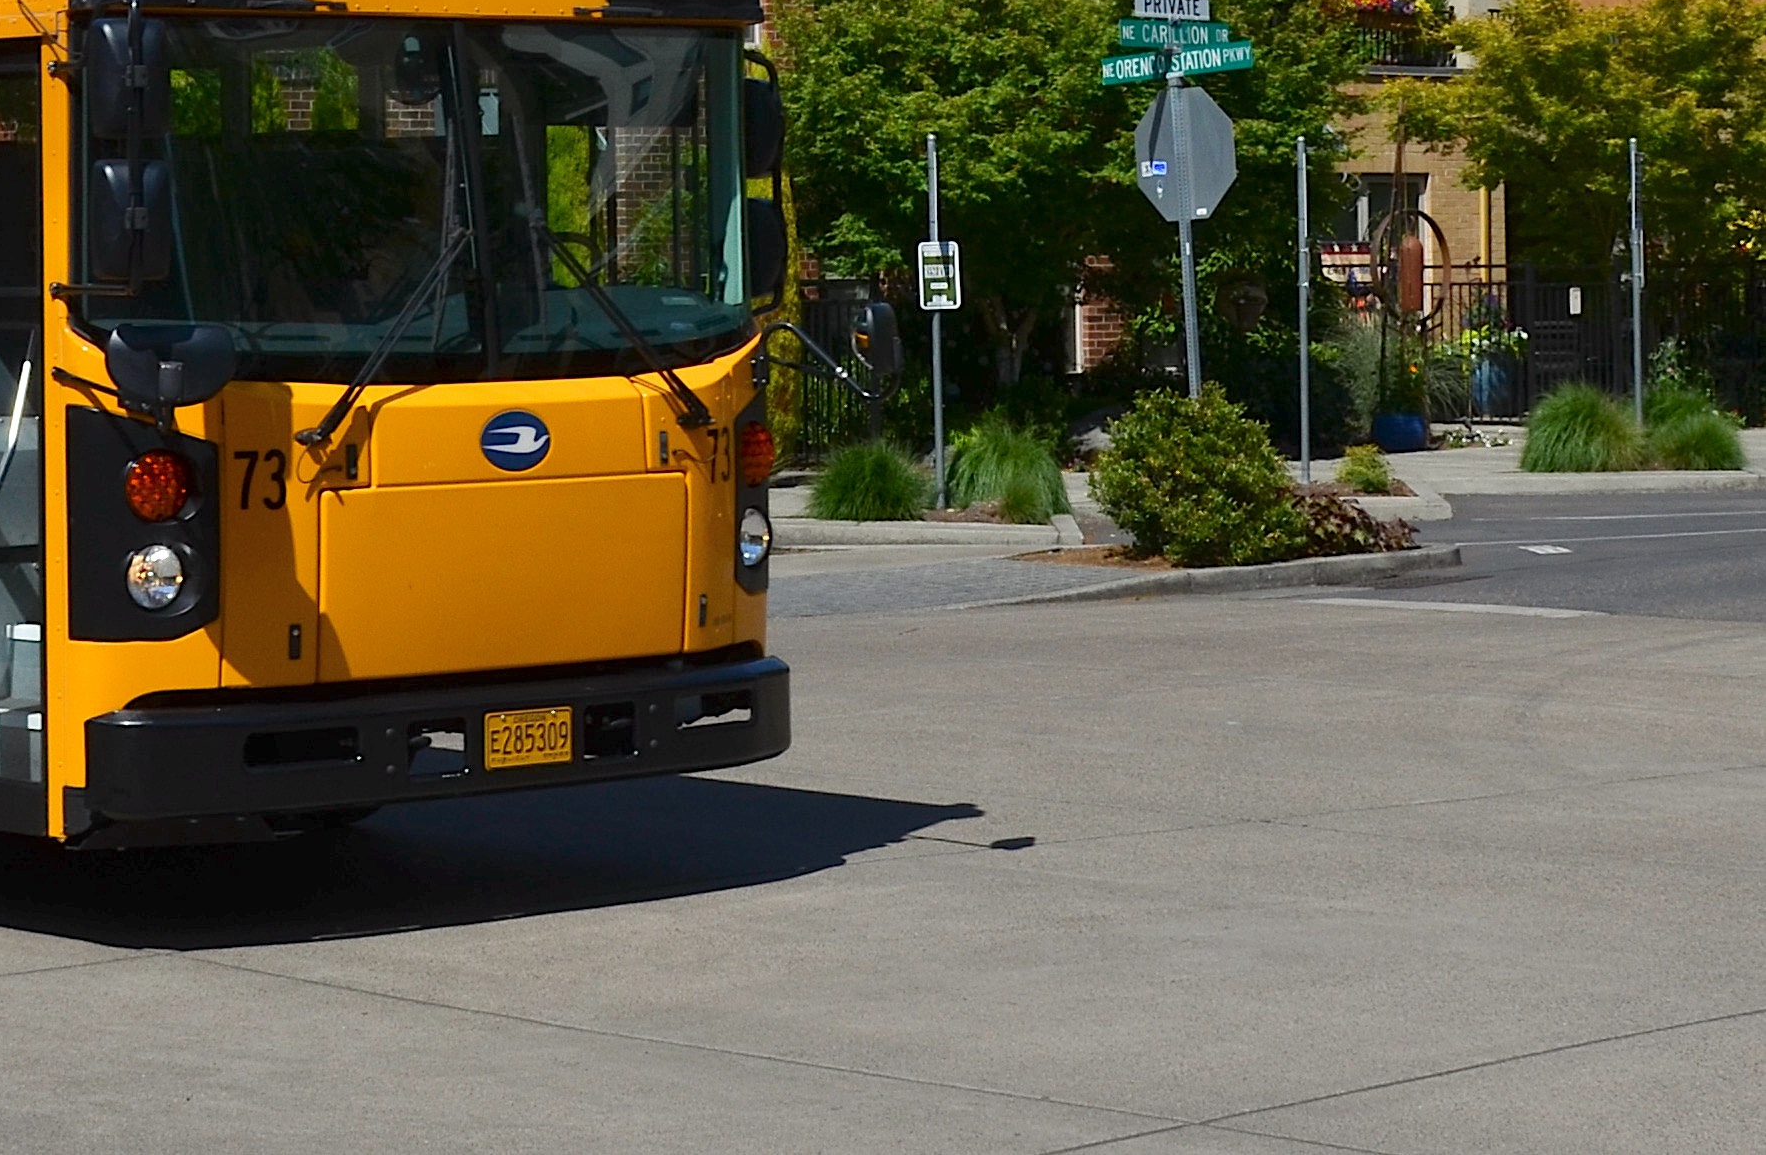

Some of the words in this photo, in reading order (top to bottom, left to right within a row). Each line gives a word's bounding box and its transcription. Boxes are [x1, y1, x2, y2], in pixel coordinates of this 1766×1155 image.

[1122, 26, 1135, 40] NE
[1142, 24, 1208, 45] CARILLION
[1216, 28, 1229, 43] DR
[1103, 62, 1115, 78] NE
[1115, 55, 1166, 79] ORENCO
[1171, 48, 1222, 72] STATION
[1222, 45, 1251, 63] PKWY
[706, 427, 730, 484] 73
[234, 449, 287, 510] 73
[491, 720, 568, 755] E285309
